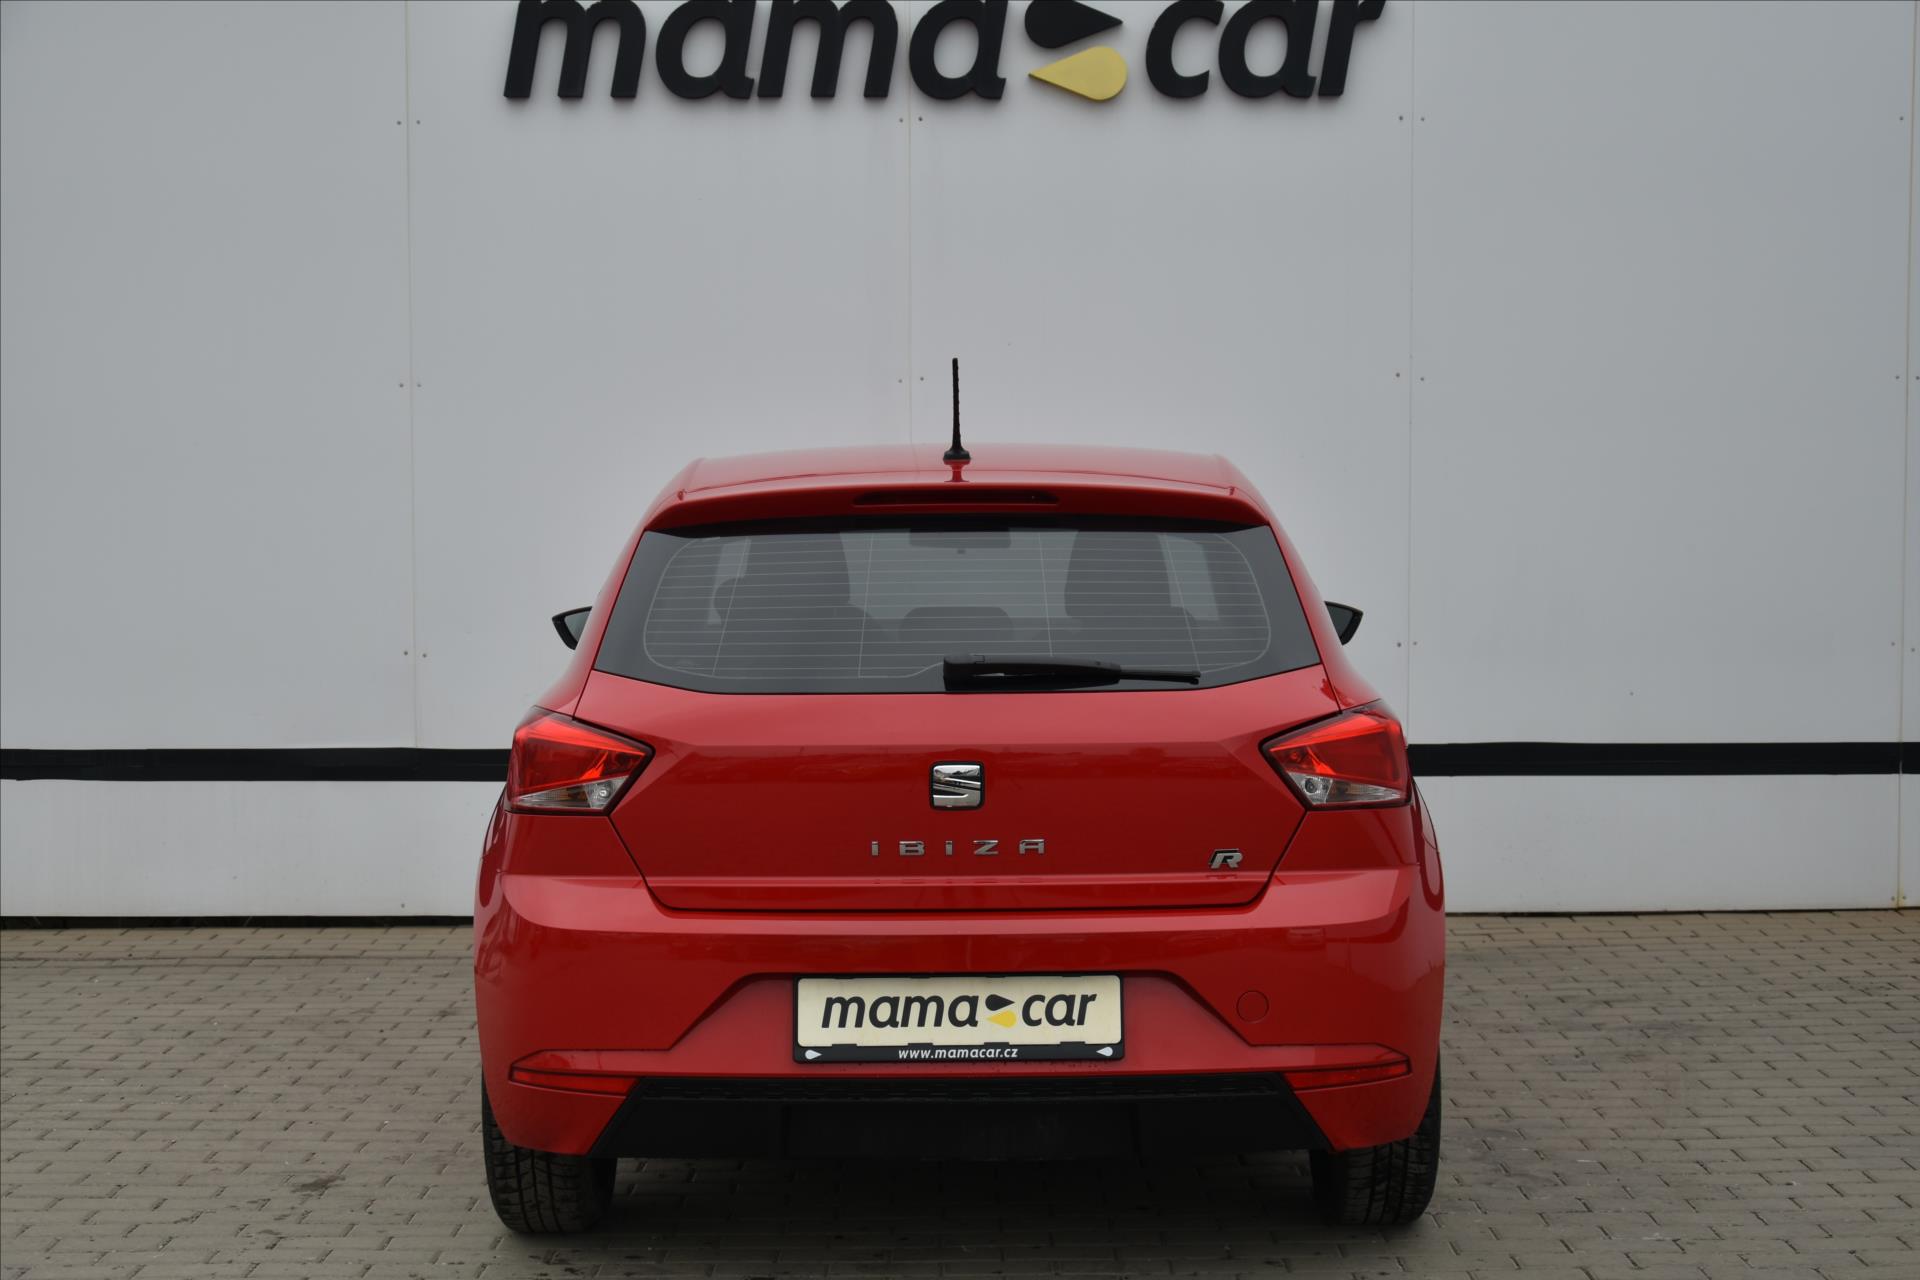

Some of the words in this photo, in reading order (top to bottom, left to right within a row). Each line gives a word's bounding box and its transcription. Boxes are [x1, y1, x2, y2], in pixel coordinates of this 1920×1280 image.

[503, 0, 1008, 100] mama
[1144, 0, 1387, 98] car
[1208, 848, 1243, 869] R
[821, 994, 979, 1028] mama
[1021, 993, 1097, 1027] car
[898, 1046, 1018, 1059] www.mamacar.cz
